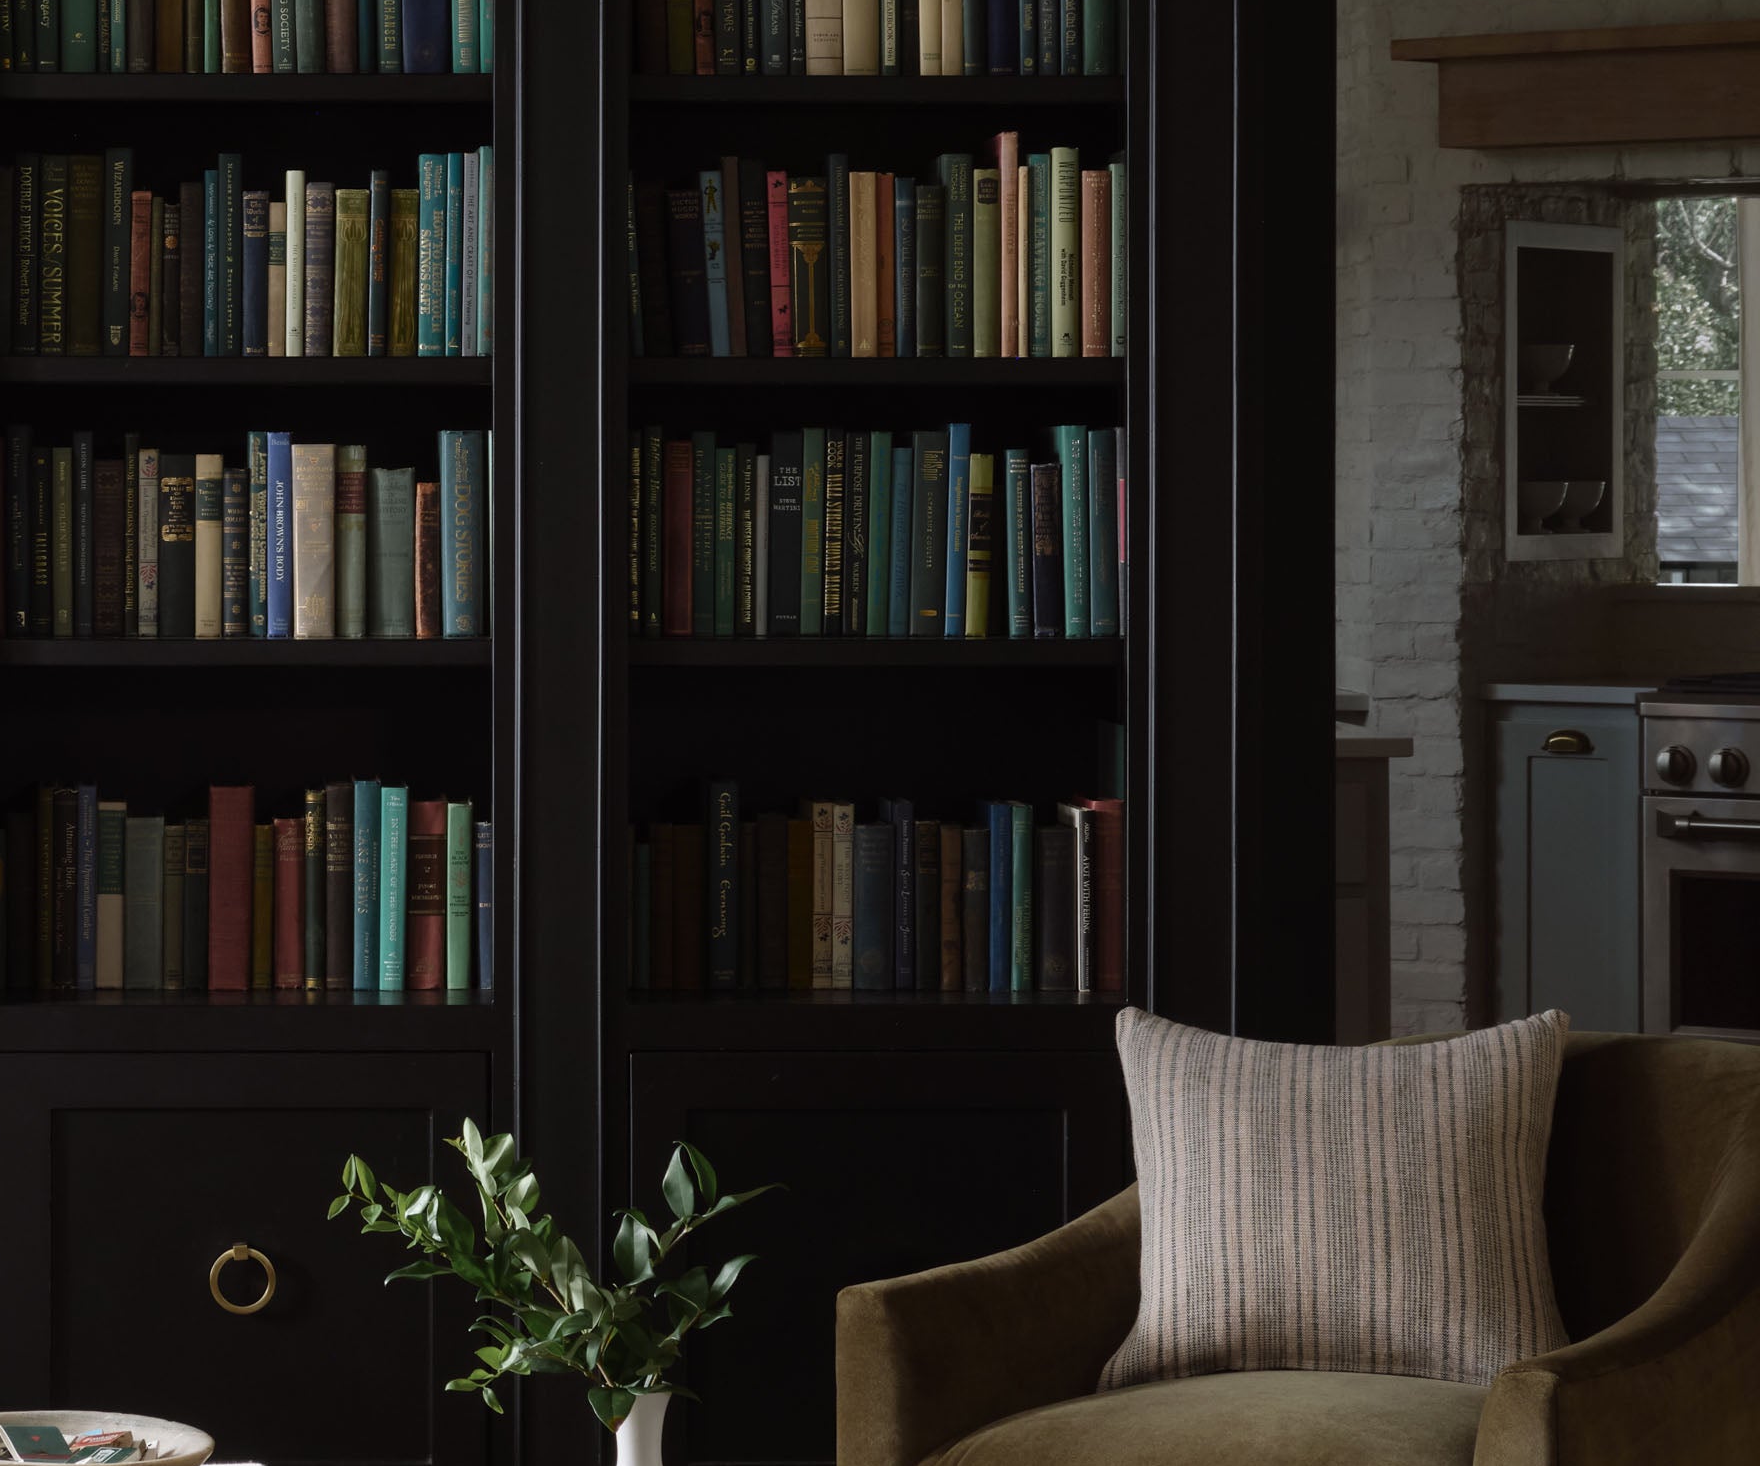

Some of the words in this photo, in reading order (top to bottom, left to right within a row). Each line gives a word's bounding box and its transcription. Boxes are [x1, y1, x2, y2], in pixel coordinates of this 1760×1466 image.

[280, 8, 289, 52] SOCIETY
[20, 167, 32, 212] DOUBLE
[113, 161, 124, 225] WIZARDBORN
[1059, 161, 1075, 223] WEAPONIZED
[19, 215, 32, 252] DEUCE
[41, 189, 64, 254] VOICES
[954, 213, 963, 231] THE
[420, 229, 431, 280] SAVINGS
[954, 234, 963, 257] DEEP
[466, 270, 472, 279] OF
[955, 260, 964, 280] END
[41, 267, 62, 344] SUMMER
[420, 283, 430, 315] SAFE
[955, 292, 964, 328] OCEAN
[828, 441, 836, 468] COOK
[276, 481, 284, 508] JOHN
[774, 476, 801, 486] LIST
[827, 474, 842, 499] WALL
[454, 485, 471, 525] DOG
[826, 501, 842, 537] STREET
[276, 511, 284, 552] BROWN'S
[276, 556, 284, 581] BODY
[456, 530, 472, 602] STORIES
[826, 541, 841, 571] MONEY
[825, 574, 840, 615] MACHINE
[719, 792, 732, 818] Gail
[64, 823, 74, 864] Attracting
[719, 822, 732, 868] Godwin
[712, 879, 731, 939] Evensong
